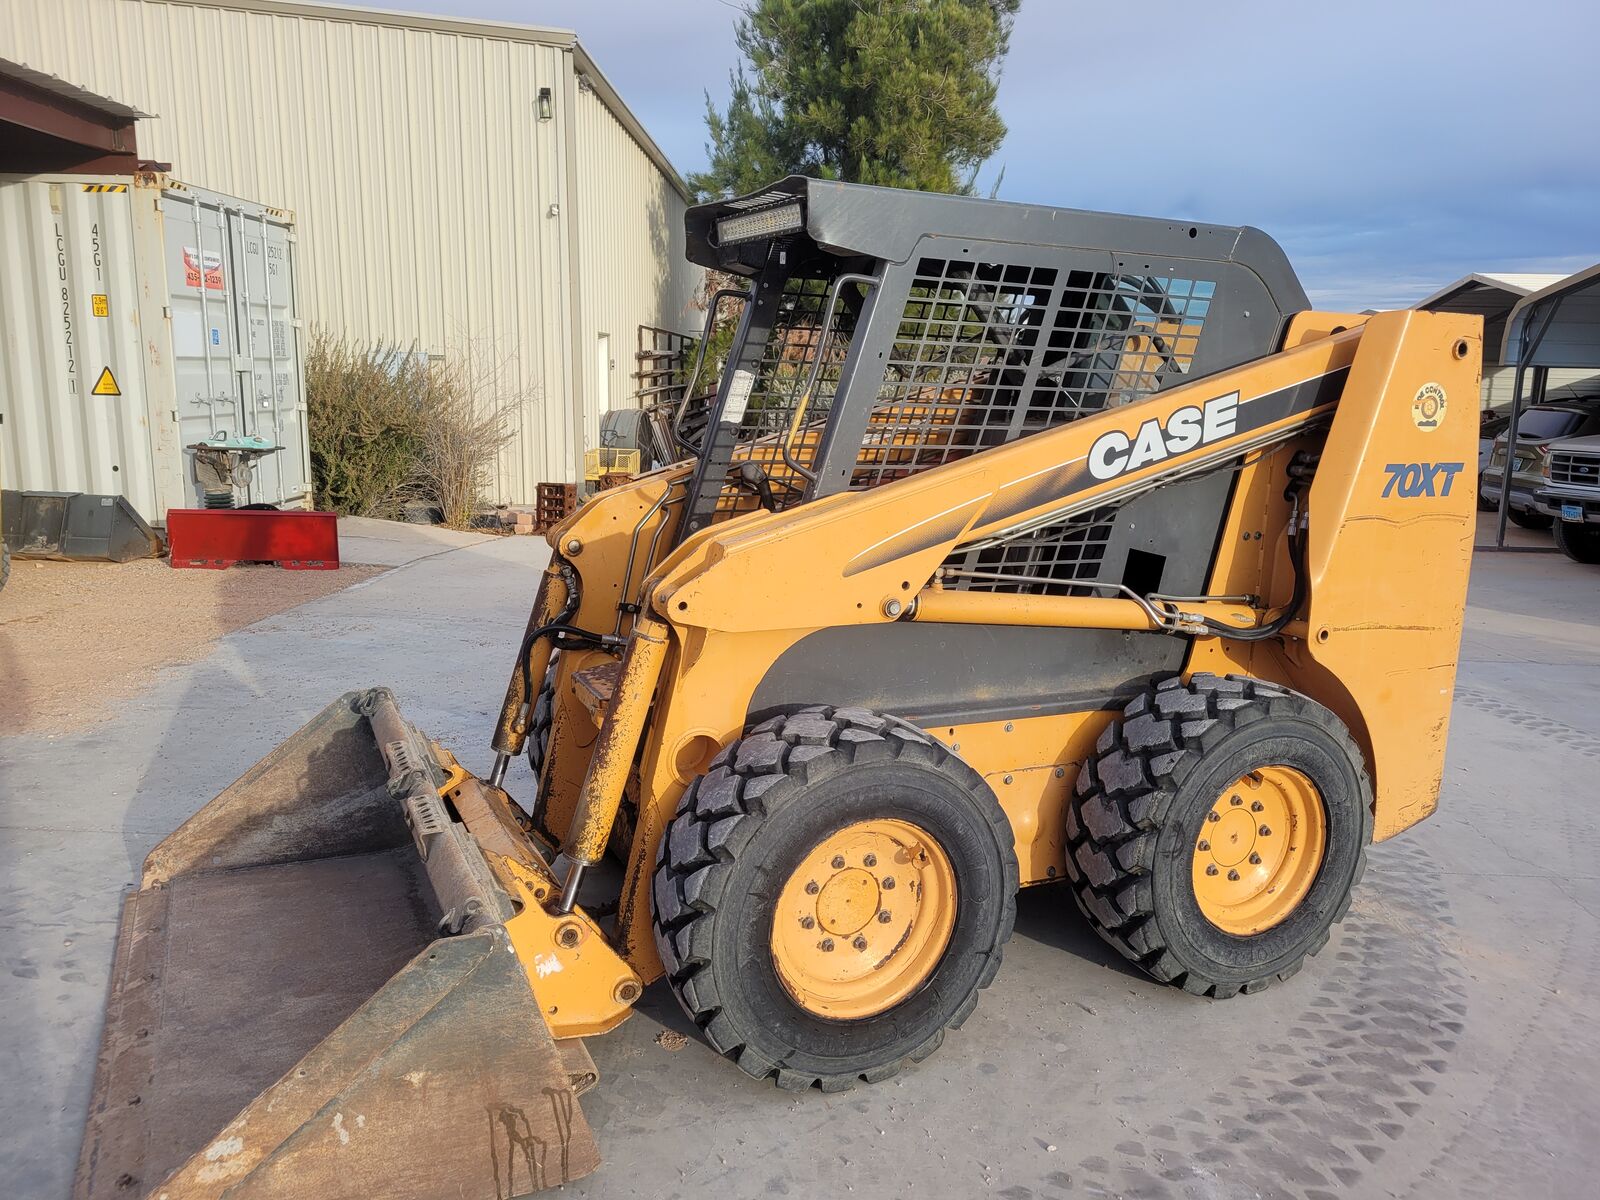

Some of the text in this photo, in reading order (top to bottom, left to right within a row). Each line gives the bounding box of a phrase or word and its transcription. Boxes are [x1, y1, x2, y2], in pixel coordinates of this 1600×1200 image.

[91, 223, 101, 281] 45G1
[54, 222, 67, 281] LCGU
[61, 287, 75, 373] 825212
[1088, 390, 1240, 480] CASE
[1381, 462, 1465, 498] 70XT
